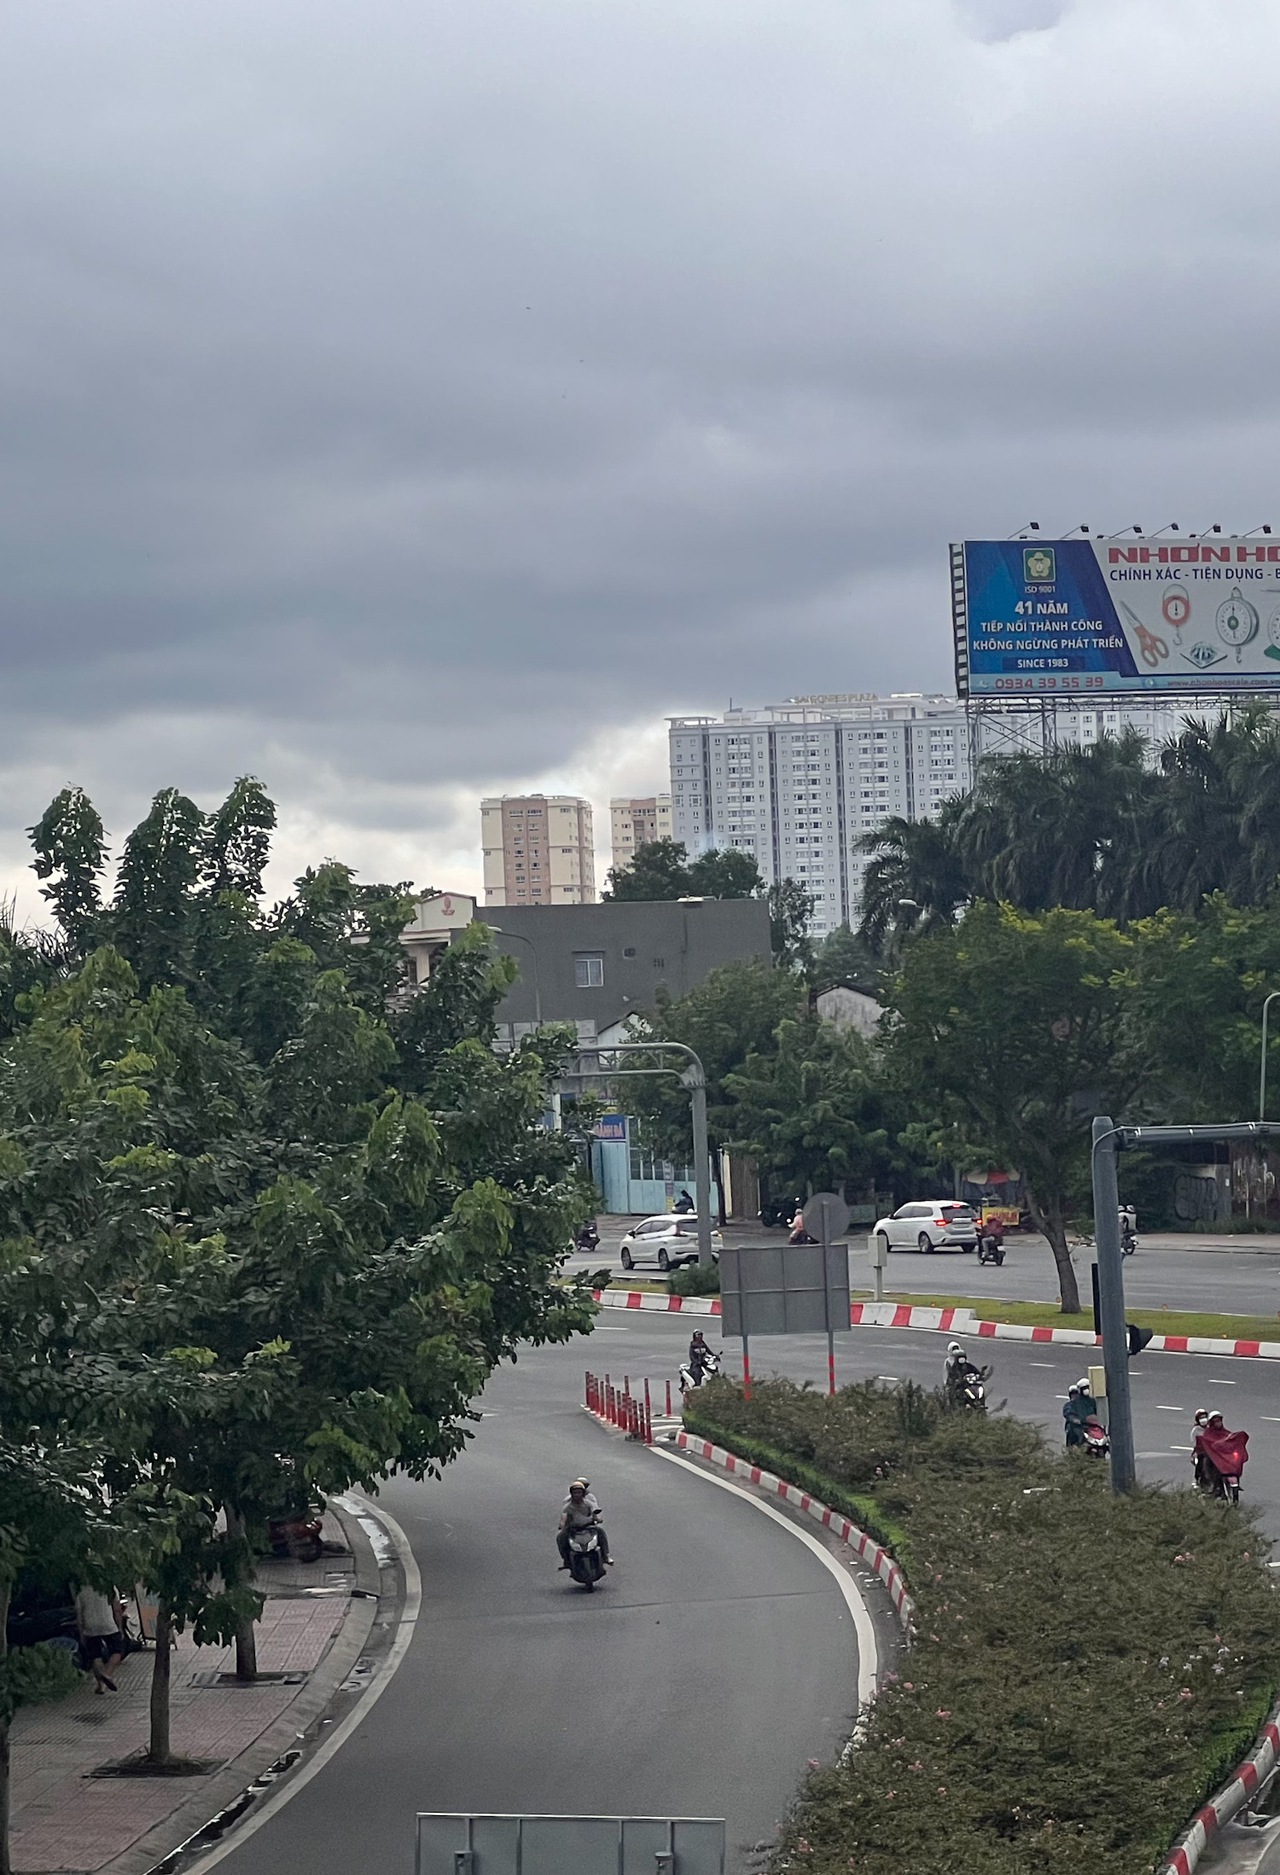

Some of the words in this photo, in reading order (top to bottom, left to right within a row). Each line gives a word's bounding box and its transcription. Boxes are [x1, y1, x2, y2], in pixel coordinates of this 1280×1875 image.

[1108, 543, 1231, 564] NHƠN
[1109, 567, 1151, 581] CHÍNH
[1156, 567, 1181, 580] XÁC
[1192, 567, 1221, 583] TIỆN
[1225, 567, 1264, 583] DỤNG
[1024, 585, 1038, 594] ISO
[1038, 585, 1056, 593] 9001
[1014, 600, 1033, 615] 41
[1037, 600, 1069, 615] NĂM
[980, 619, 1004, 632] TIẾP
[1006, 619, 1027, 632] NỐI
[1029, 619, 1069, 632] THÀNH
[1071, 620, 1103, 631] CÔNG
[973, 637, 1014, 651] KHÔNG
[1016, 636, 1058, 650] NGỪNG
[1061, 636, 1089, 649] PHÁT
[1092, 634, 1124, 649] TRIỂN
[1017, 658, 1045, 669] SINCE
[1047, 658, 1069, 668] 1983
[995, 678, 1034, 690] 0934
[1038, 677, 1057, 689] 39
[1062, 677, 1080, 688] 55
[1085, 676, 1104, 688] 39
